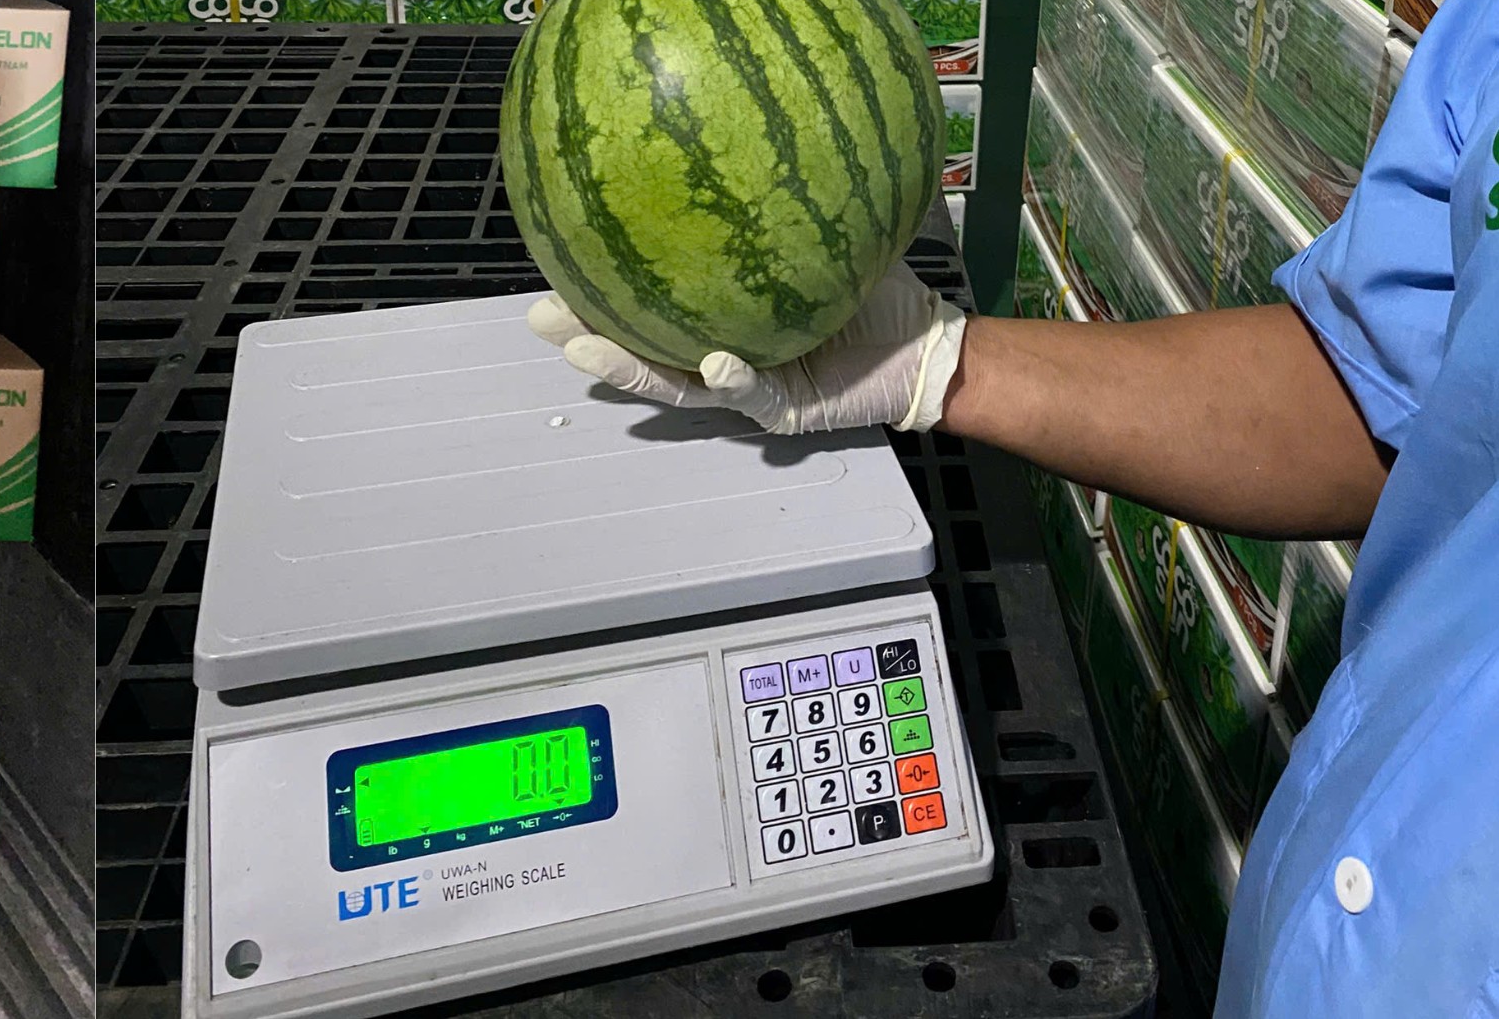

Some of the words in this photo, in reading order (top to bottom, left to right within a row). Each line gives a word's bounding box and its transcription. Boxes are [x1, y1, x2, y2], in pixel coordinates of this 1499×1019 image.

[885, 646, 899, 659] HI
[798, 668, 821, 684] M+
[849, 659, 861, 674] U
[900, 659, 917, 672] LO
[749, 676, 778, 691] TOTAL
[808, 701, 825, 725] 8
[854, 692, 871, 716] 9
[762, 709, 779, 734] 7
[813, 739, 831, 764] 5
[859, 731, 876, 755] 6
[766, 747, 784, 772] 4
[820, 779, 837, 804] 2
[865, 770, 882, 794] 3
[774, 787, 787, 813] 1
[873, 815, 884, 831] P
[913, 804, 937, 822] CE
[423, 838, 431, 849] g
[778, 829, 795, 854] 0
[441, 861, 488, 880] UWA-N
[442, 873, 515, 901] WEIGHING
[521, 862, 566, 885] SCALE
[338, 876, 420, 921] UTE
